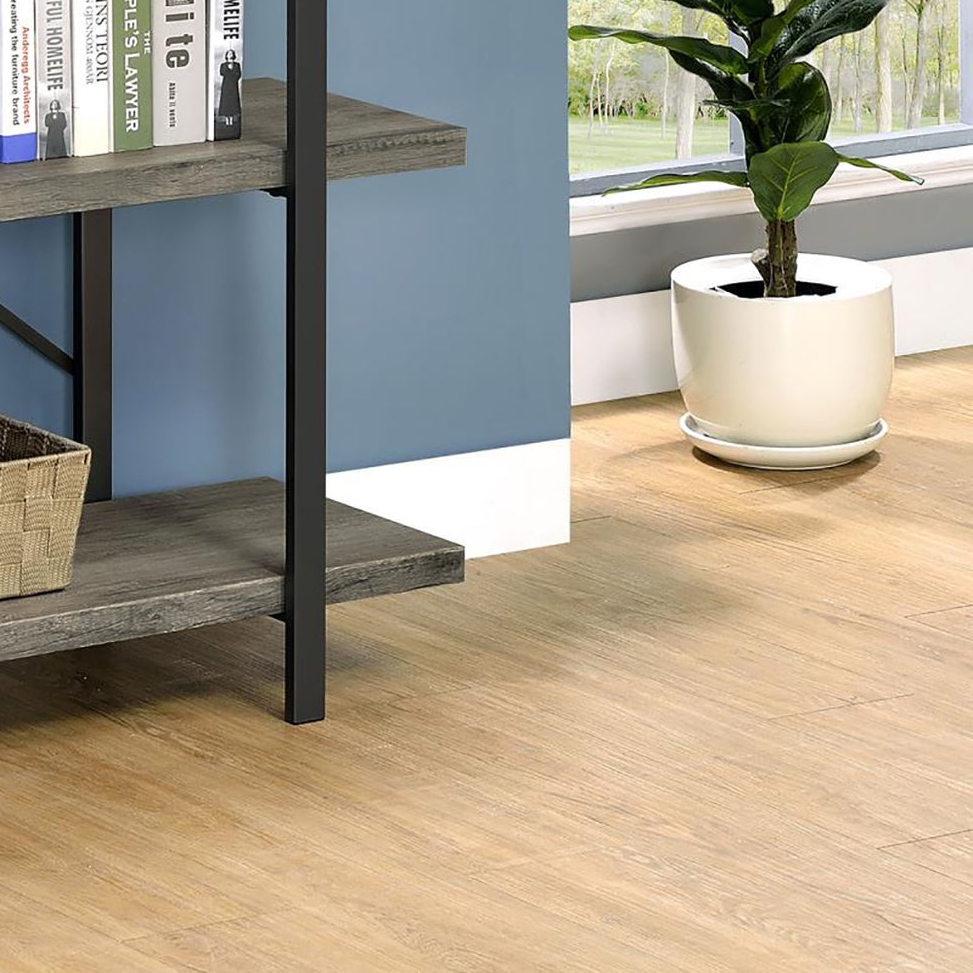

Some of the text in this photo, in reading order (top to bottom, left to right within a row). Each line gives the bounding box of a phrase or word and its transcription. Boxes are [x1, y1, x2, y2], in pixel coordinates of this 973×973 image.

[11, 35, 19, 51] the
[46, 26, 64, 91] HOMELIFE
[95, 32, 109, 82] TEORI
[165, 34, 193, 68] te
[11, 54, 20, 95] furniture
[21, 27, 31, 125] Anderegg Architects
[124, 53, 140, 133] LAWYER
[12, 98, 21, 126] brand
